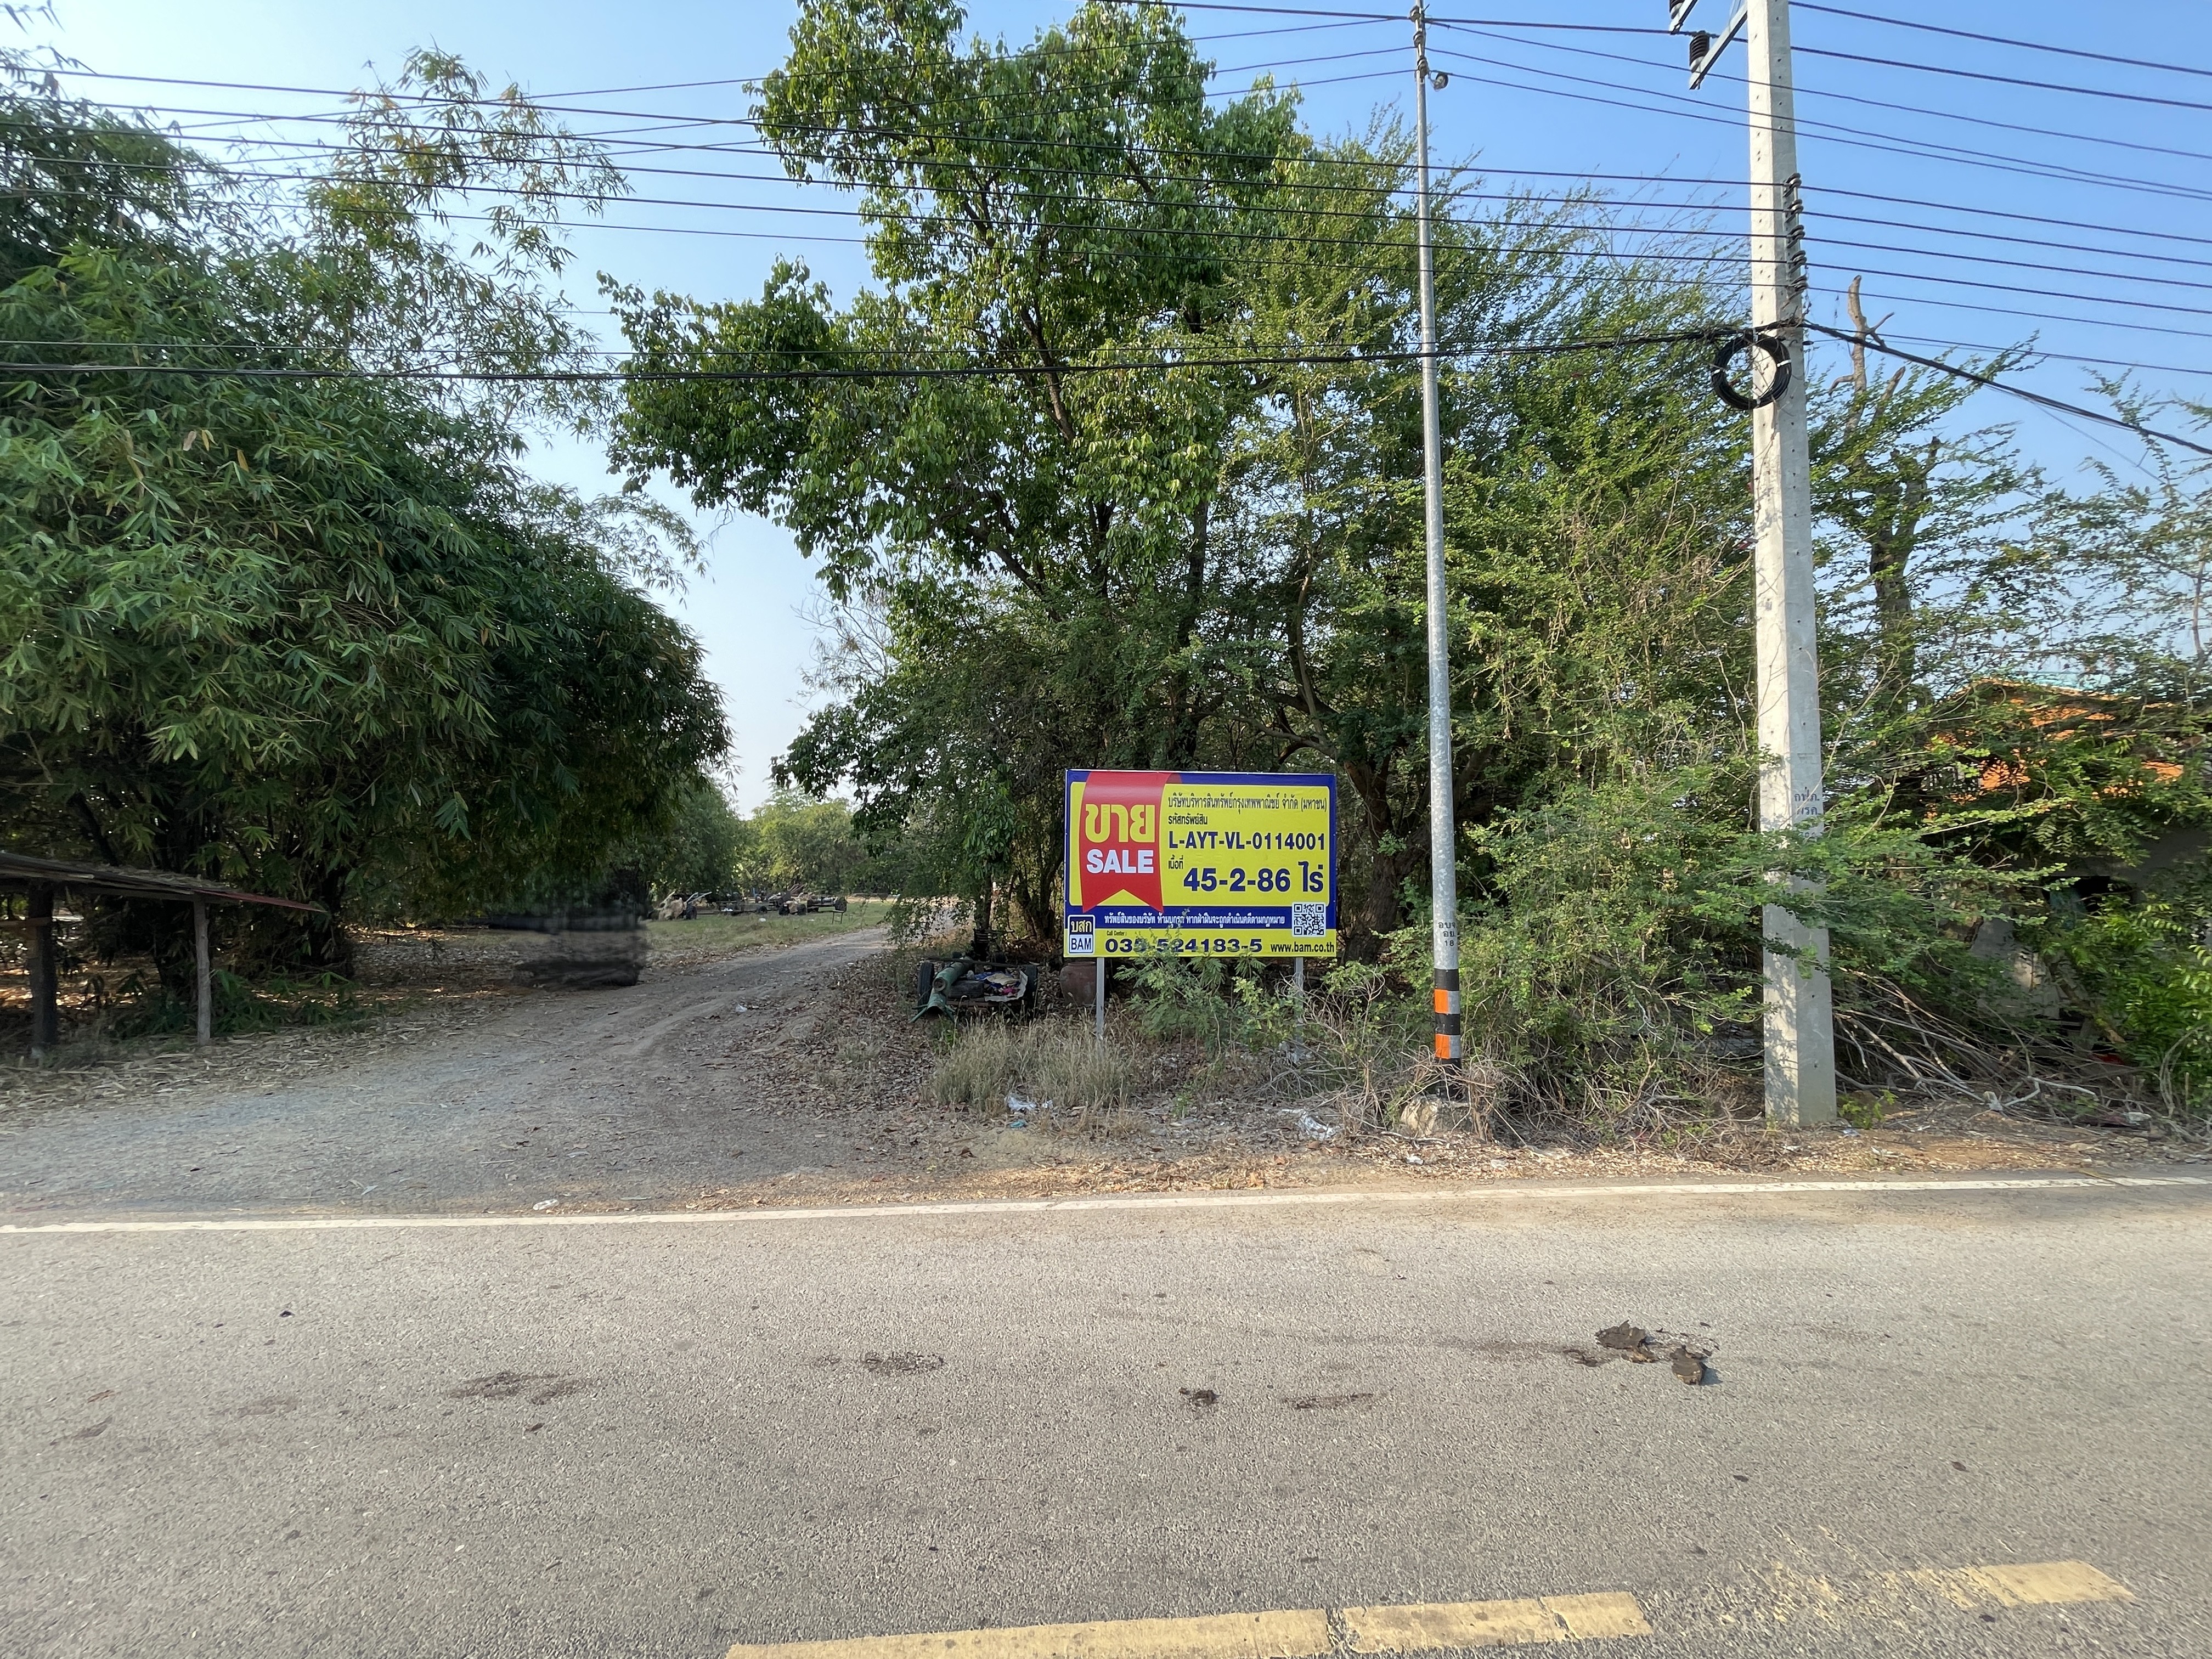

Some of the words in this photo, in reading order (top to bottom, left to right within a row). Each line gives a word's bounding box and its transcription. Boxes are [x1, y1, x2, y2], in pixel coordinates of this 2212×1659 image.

[1168, 792, 1279, 814] บริษัทบริหารสินทรัพย์กรุงเทพพาณิชย์
[1282, 793, 1298, 809] จำกัด
[1301, 797, 1327, 812] (มหาชน)
[1085, 804, 1155, 843] ขาย
[1168, 812, 1208, 825] รหัสทรัพย์สิน
[1169, 831, 1325, 850] L-AYT-VL-0114001
[1086, 849, 1154, 873] SALE
[1168, 854, 1184, 870] เนื้อที่
[1183, 867, 1291, 892] 45-2-86
[1298, 861, 1324, 892] ไร่
[1104, 911, 1156, 924] ทรัพย์สินของบริษัท
[1071, 921, 1092, 933] บสก
[1071, 938, 1092, 950] BAM
[1271, 942, 1335, 953] www.bam.co.th
